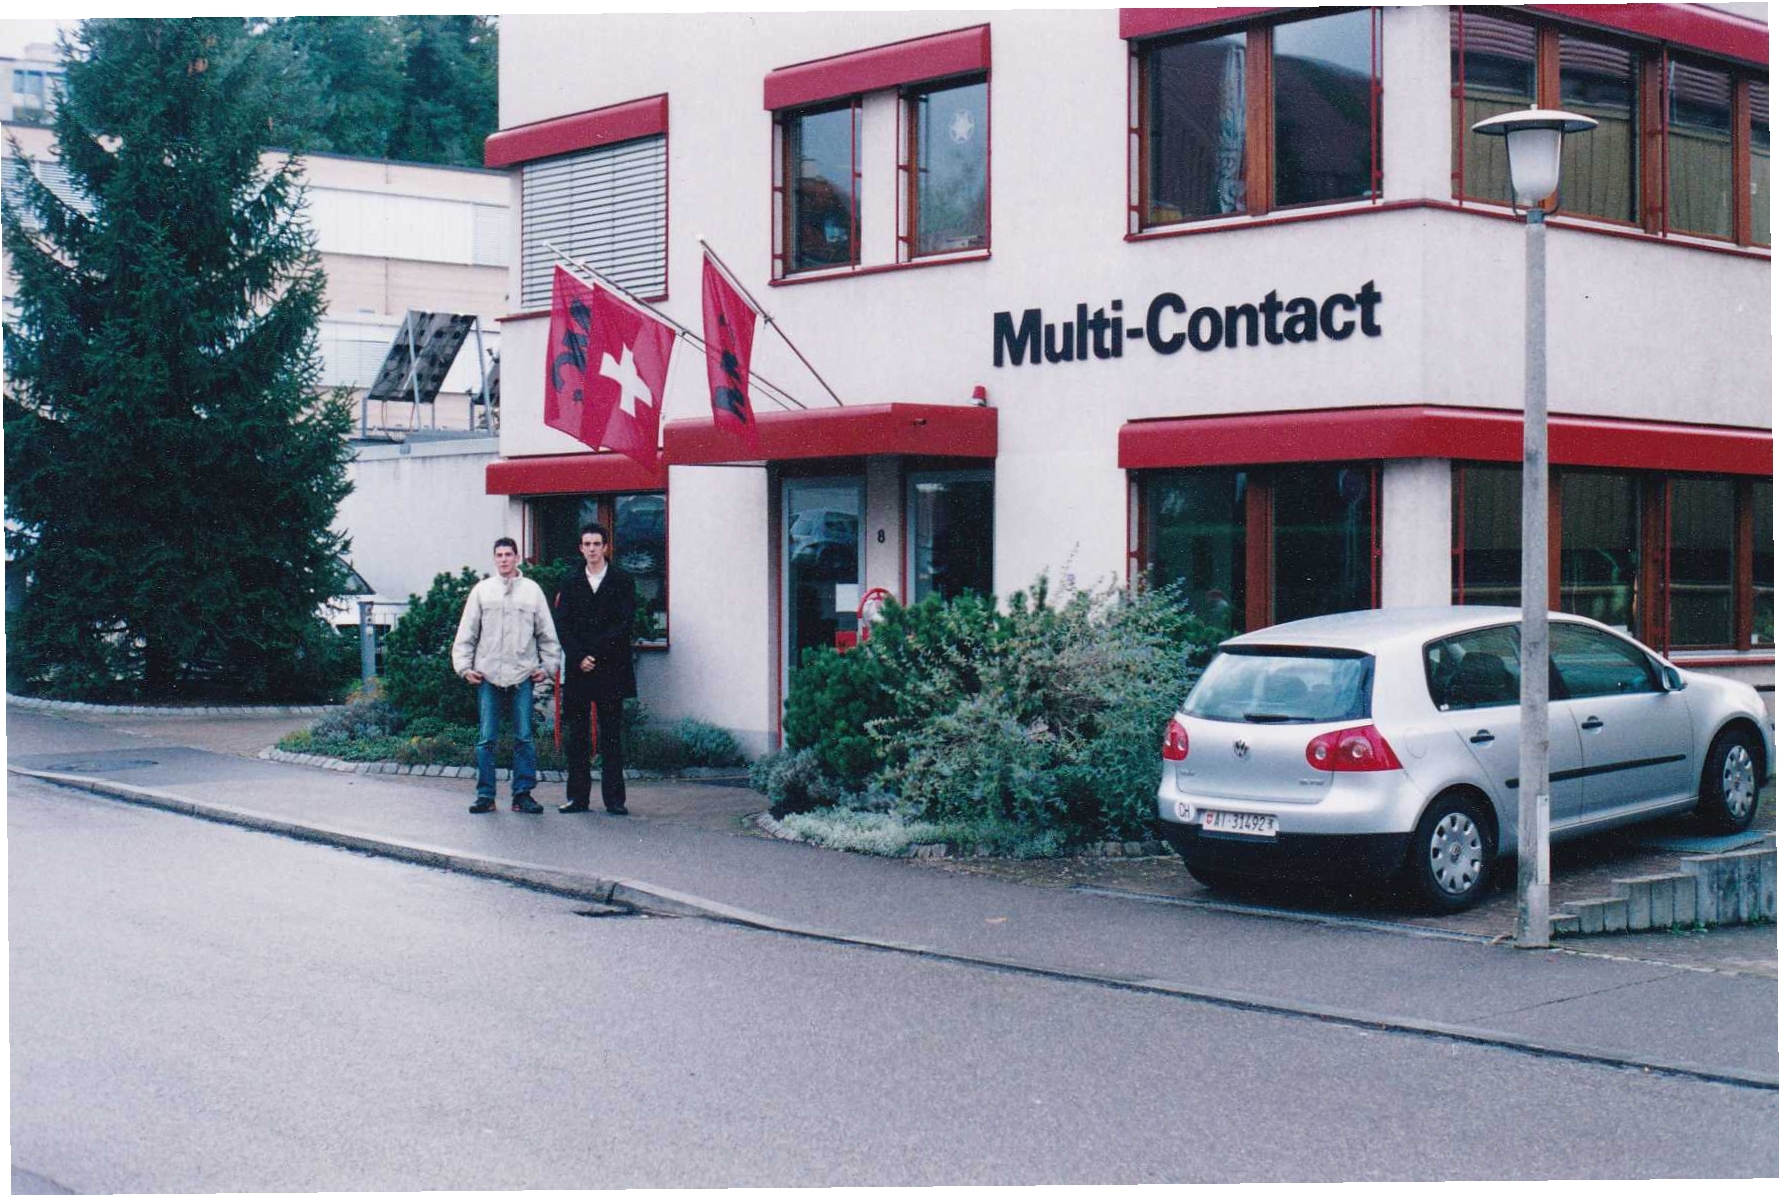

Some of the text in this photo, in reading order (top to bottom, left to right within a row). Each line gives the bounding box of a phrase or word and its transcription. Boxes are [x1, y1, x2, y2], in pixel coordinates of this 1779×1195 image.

[993, 280, 1382, 367] Multi-Contact
[876, 528, 886, 544] 8
[1179, 802, 1191, 818] CH
